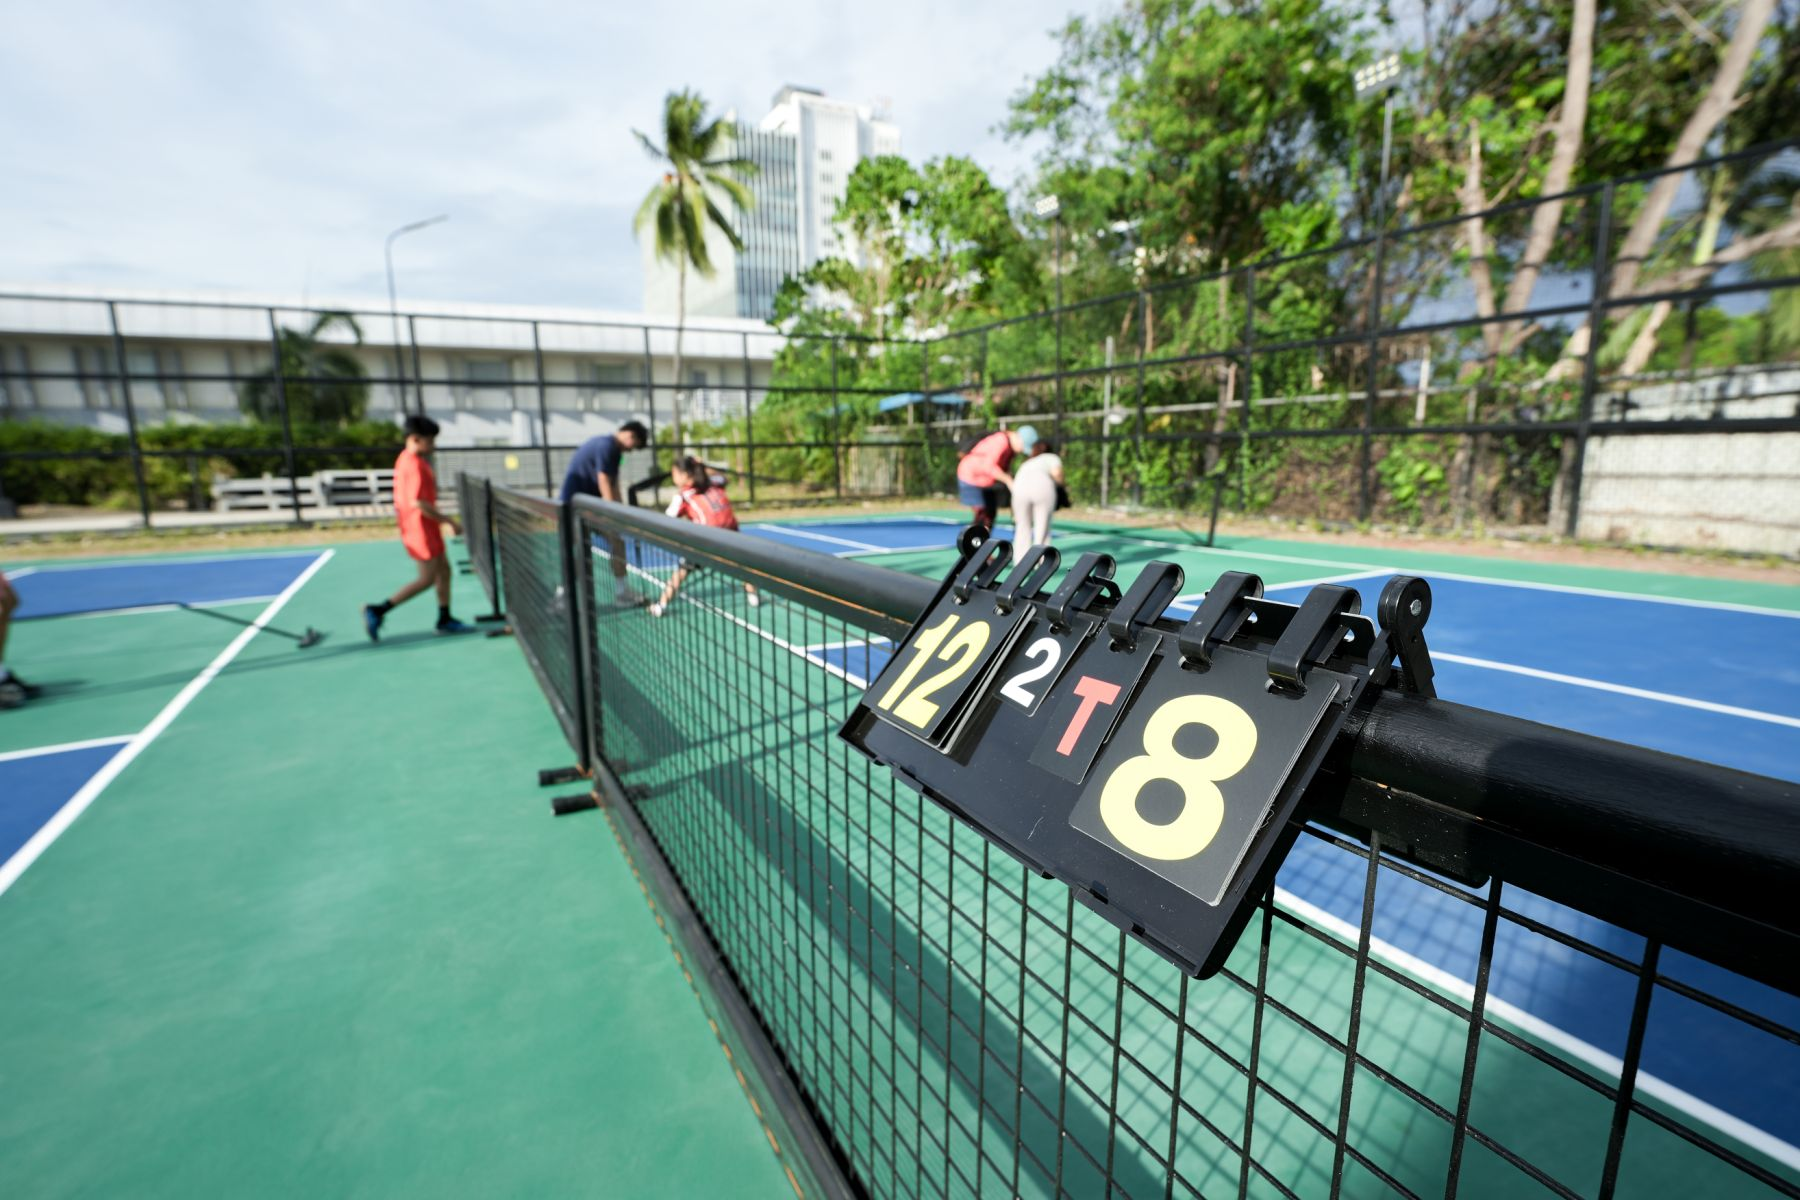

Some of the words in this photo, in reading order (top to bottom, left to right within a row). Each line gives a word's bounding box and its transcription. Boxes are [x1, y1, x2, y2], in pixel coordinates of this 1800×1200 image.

[877, 614, 991, 729] 12
[999, 636, 1062, 708] 2
[1055, 675, 1122, 757] T
[1099, 693, 1258, 862] 8
